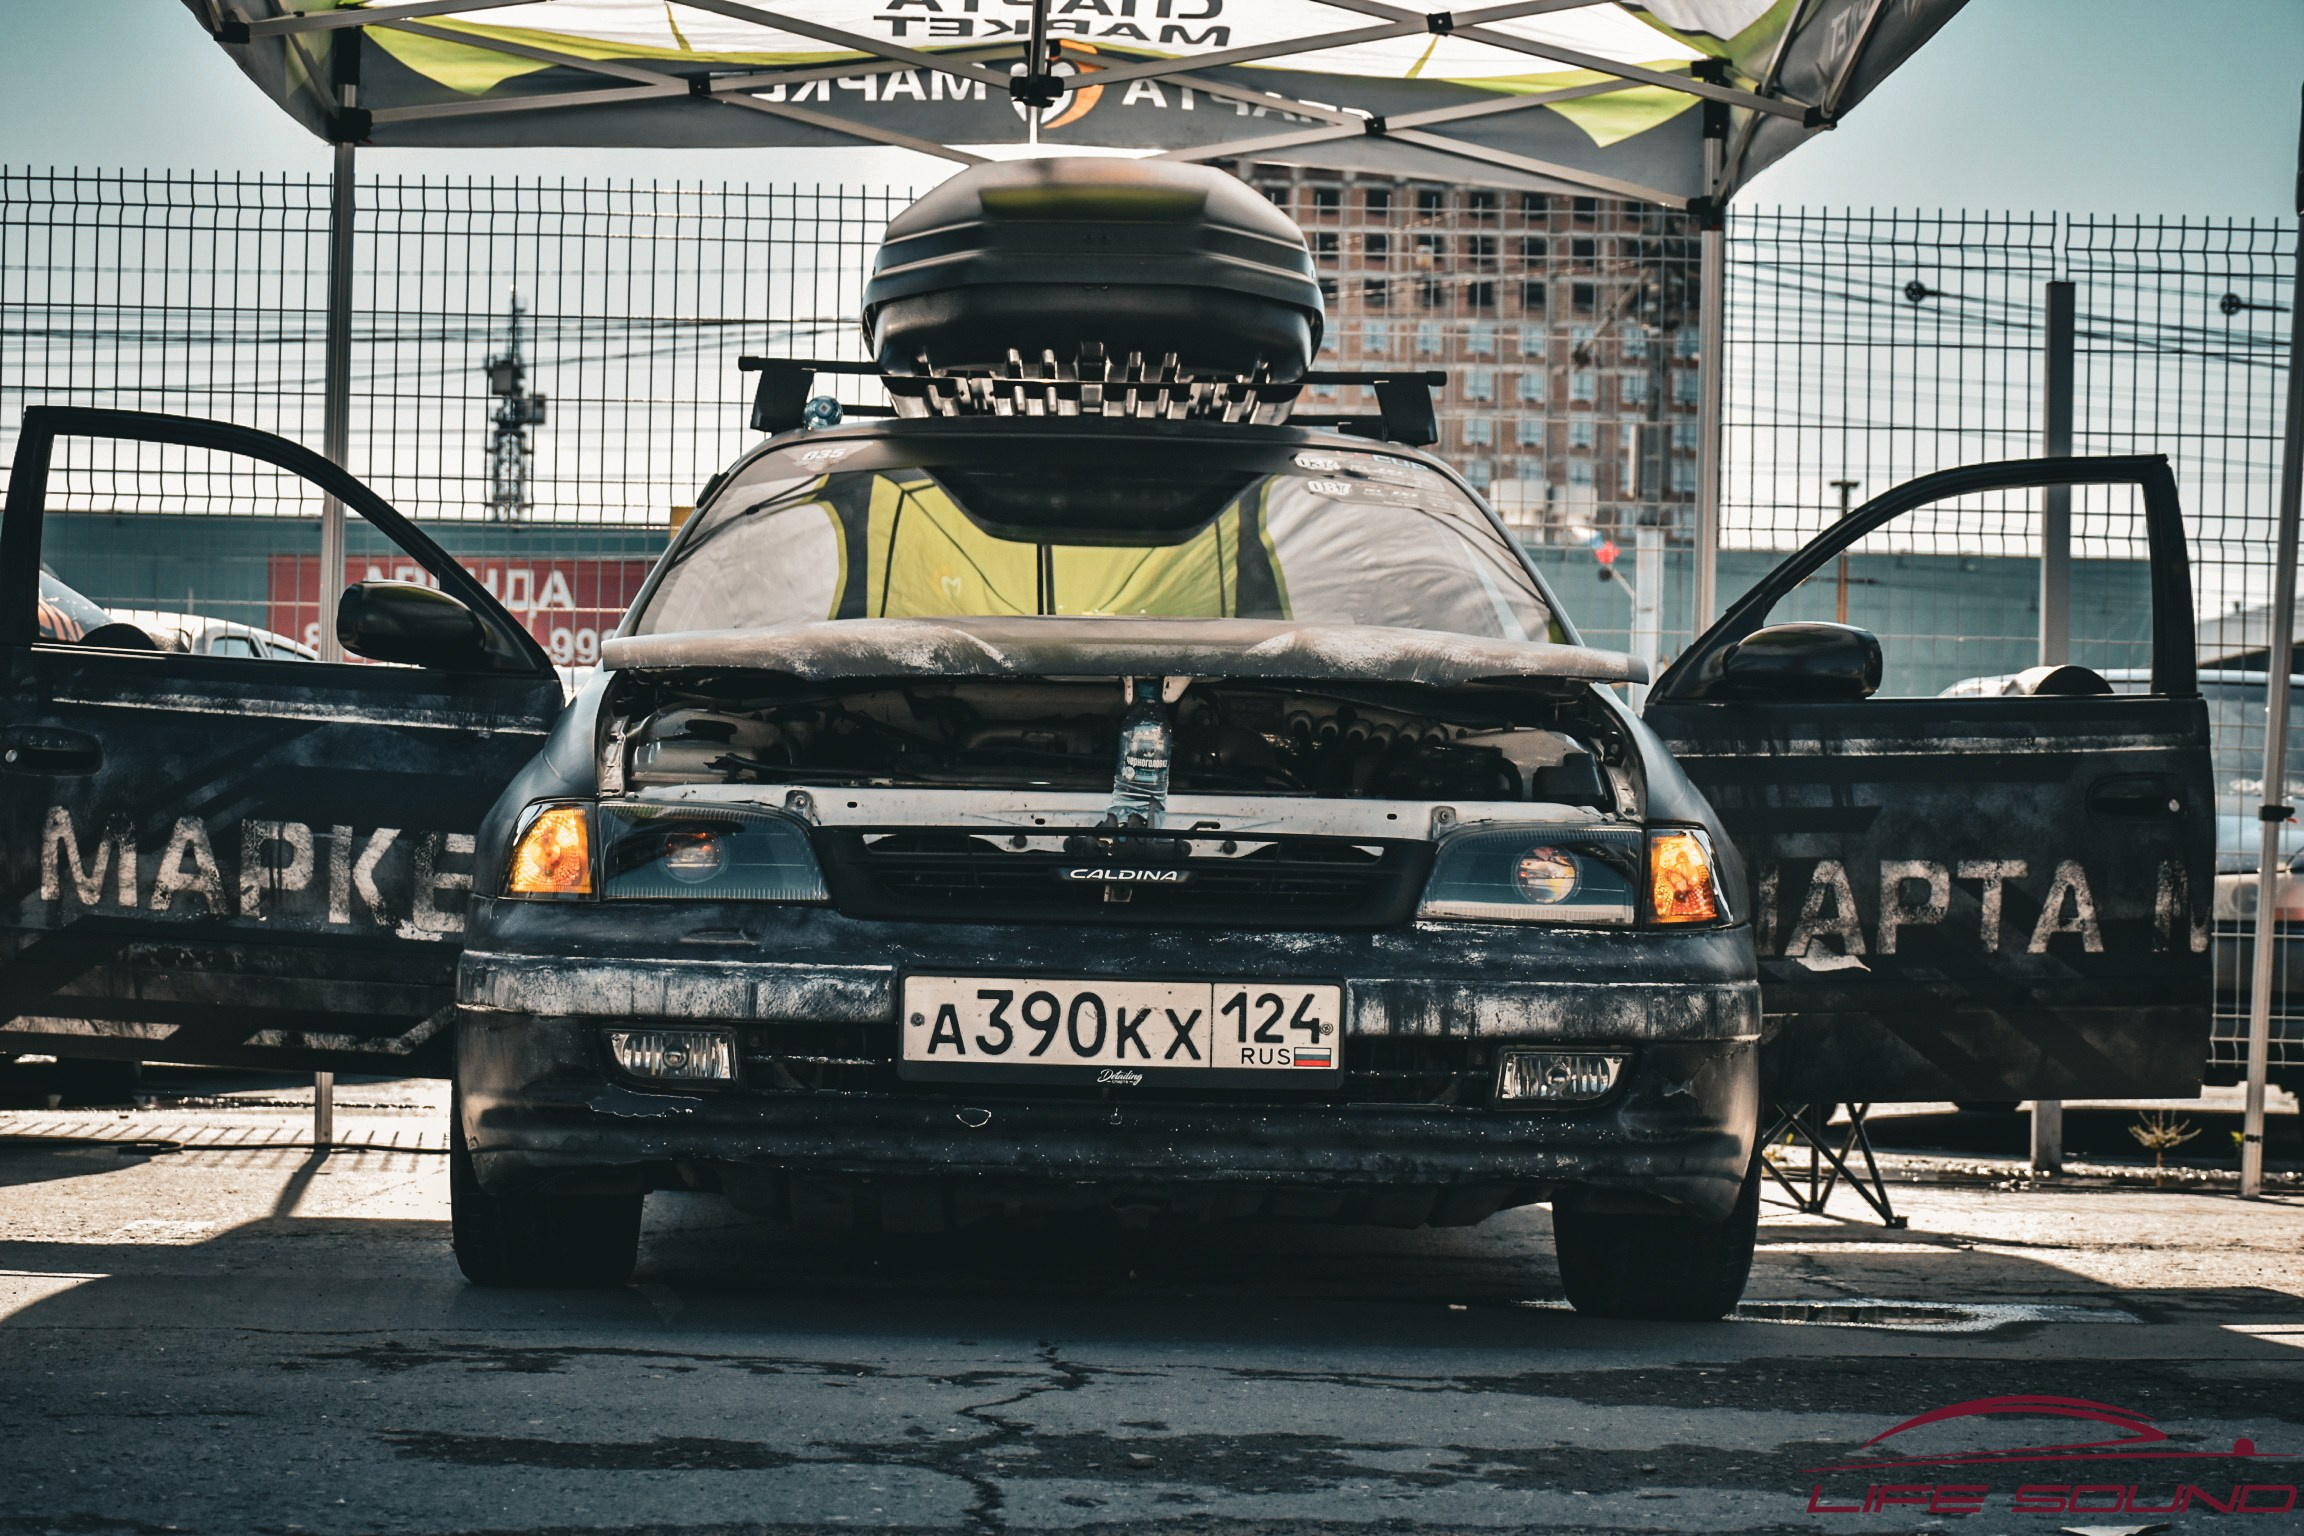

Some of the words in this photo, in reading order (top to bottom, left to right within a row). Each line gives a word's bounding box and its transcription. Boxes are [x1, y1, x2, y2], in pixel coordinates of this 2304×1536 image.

[362, 565, 575, 622] РНДА
[1070, 868, 1178, 882] CALDINA
[1221, 992, 1320, 1044] 124
[1241, 1047, 1292, 1066] RUS
[1097, 1068, 1143, 1086] Detailing
